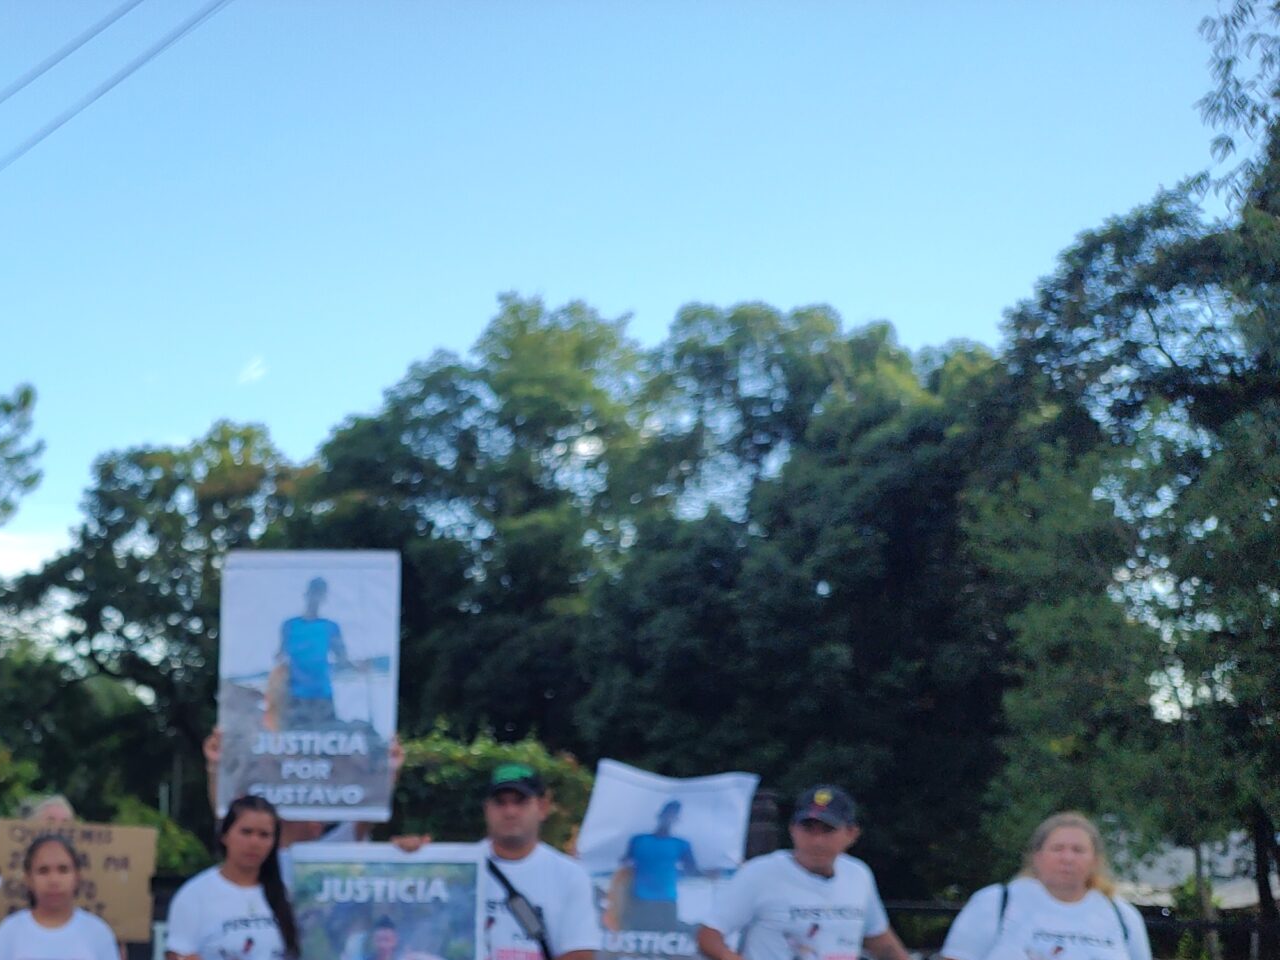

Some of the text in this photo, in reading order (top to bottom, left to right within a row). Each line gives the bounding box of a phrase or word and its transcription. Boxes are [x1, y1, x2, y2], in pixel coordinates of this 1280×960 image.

[251, 730, 369, 757] JUSTICIA
[280, 758, 333, 781] POR
[315, 876, 450, 904] JUSTICIA
